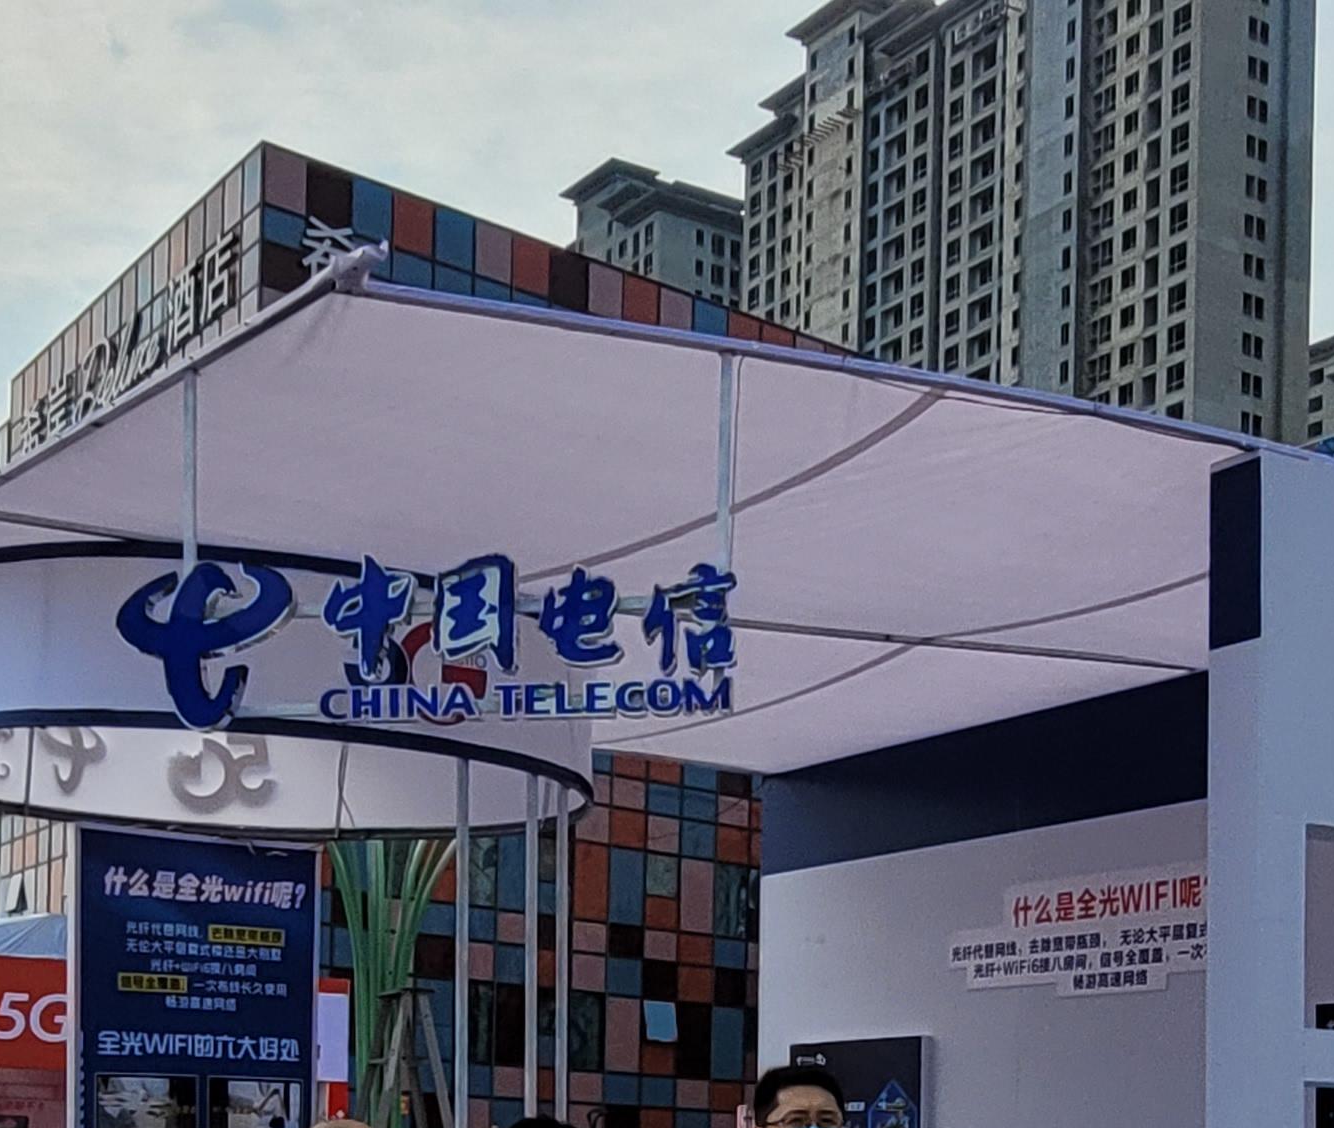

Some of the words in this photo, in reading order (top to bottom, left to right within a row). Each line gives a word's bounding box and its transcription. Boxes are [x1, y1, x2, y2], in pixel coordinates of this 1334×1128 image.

[323, 553, 738, 675] 中国电信
[320, 684, 476, 720] CHINA
[493, 677, 736, 718] TELECOM
[103, 866, 306, 909] 什么是全光wifi呢?
[98, 1030, 300, 1062] 全光WIFI的六大好处
